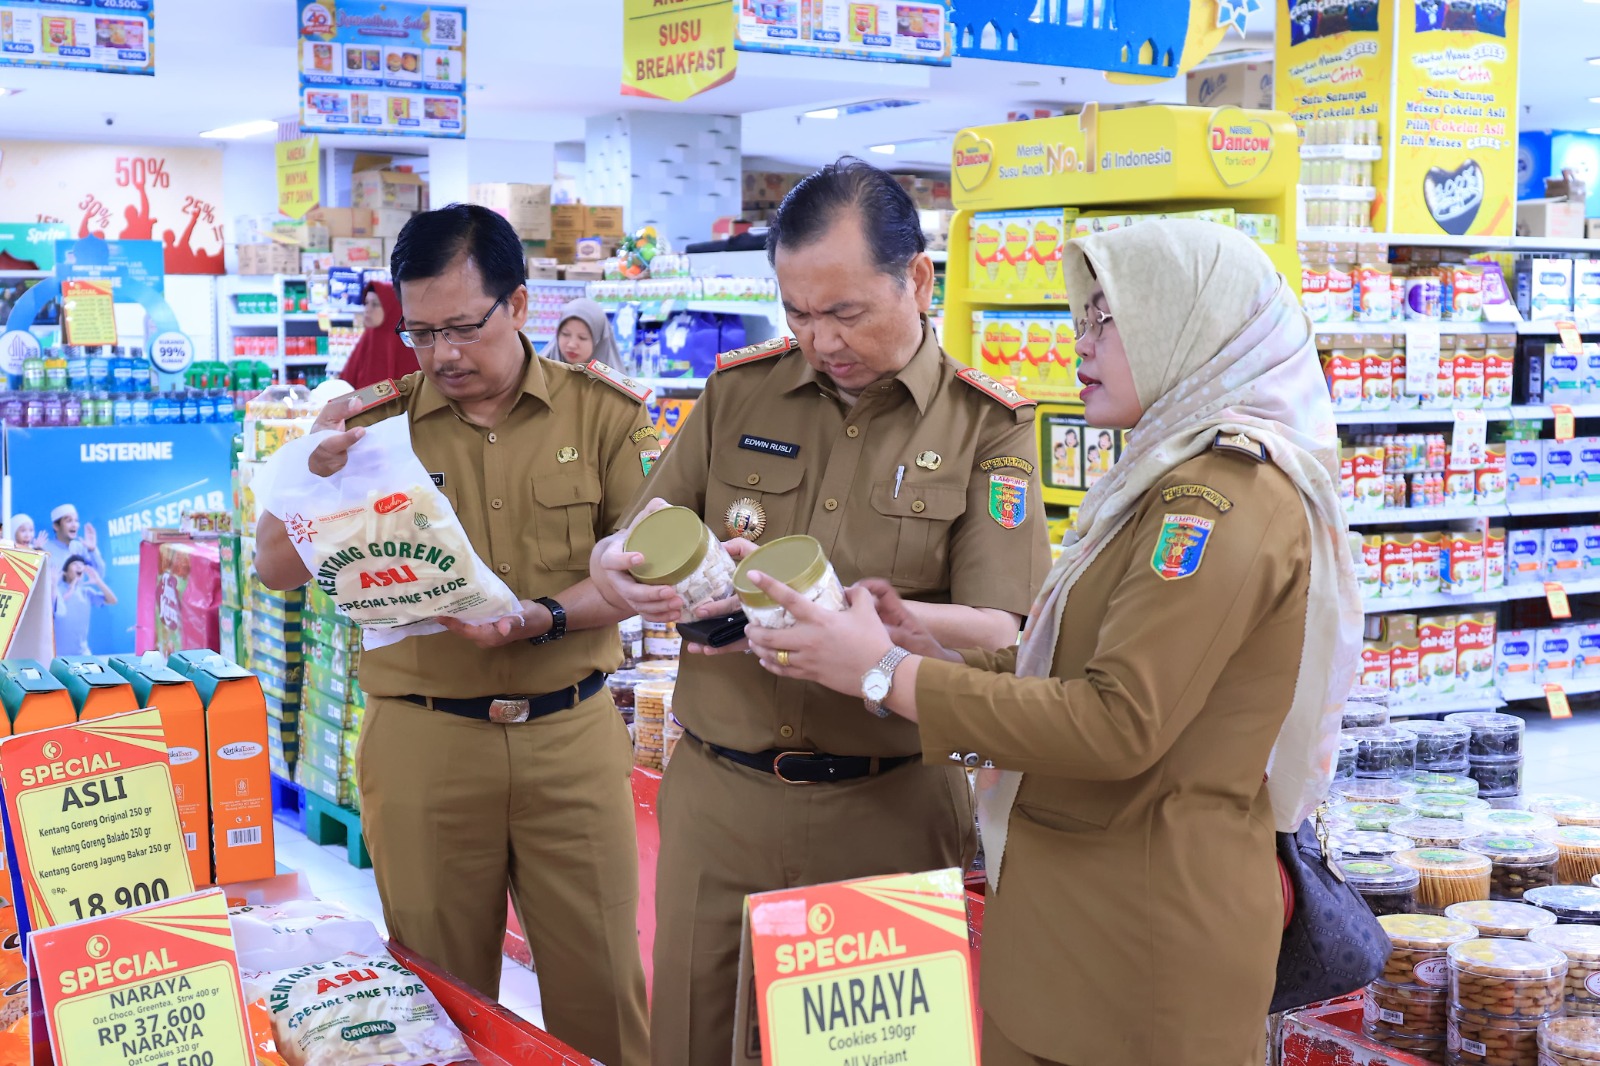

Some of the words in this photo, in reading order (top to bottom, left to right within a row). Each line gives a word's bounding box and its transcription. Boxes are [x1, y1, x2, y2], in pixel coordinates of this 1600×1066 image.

[659, 18, 701, 46] SUSU
[636, 46, 725, 81] BREAKFAST
[1317, 106, 1355, 118] Cokelat
[1358, 104, 1378, 114] Asli
[1405, 102, 1440, 113] Meises
[1443, 104, 1482, 116] Cokelat
[1487, 108, 1505, 118] Asli
[1212, 127, 1270, 151] Dancow
[1406, 119, 1430, 131] Pilih
[1433, 120, 1478, 133] Cokelat
[1483, 123, 1504, 135] Asli
[1016, 142, 1045, 158] Merek
[1400, 135, 1424, 146] Pilih
[1428, 137, 1462, 148] Meises
[956, 150, 990, 167] Dancow
[999, 165, 1019, 179] Susu
[1022, 161, 1045, 176] Anak
[1101, 149, 1112, 169] di
[1114, 147, 1172, 169] Indonesia
[115, 157, 170, 188] 50%
[78, 194, 114, 229] 30%
[181, 195, 216, 224] 25%
[26, 228, 67, 245] Sprite
[159, 347, 186, 357] 99%
[80, 441, 173, 462] LISTERINE
[744, 438, 770, 448] EDWIN
[769, 443, 792, 453] RUSLI
[108, 509, 152, 537] NAFAS
[1167, 515, 1210, 528] LAMPUNG
[317, 546, 366, 596] KENTANG
[368, 541, 456, 572] GORENG
[360, 564, 419, 589] ASLI
[388, 592, 422, 605] PAKE
[424, 577, 468, 600] TELOR
[20, 751, 121, 787] SPECIAL
[61, 776, 128, 812] ASLI
[39, 823, 69, 838] Kentang
[71, 817, 98, 832] Goreng
[99, 809, 128, 825] Original
[129, 808, 144, 819] 250
[145, 807, 152, 817] gr
[51, 842, 80, 857] Kentang
[81, 836, 106, 851] Goreng
[106, 830, 129, 845] Balado
[130, 828, 144, 840] 250
[144, 827, 152, 838] gr
[39, 865, 70, 880] Kentang
[71, 859, 98, 874] Goreng
[99, 852, 126, 867] Jagung
[127, 847, 147, 860] Bakar
[149, 844, 163, 856] 250
[164, 842, 172, 854] gr
[775, 927, 907, 974] SPECIAL
[58, 947, 178, 995] SPECIAL
[317, 969, 380, 994] ASLI
[92, 1016, 107, 1026] Oat
[108, 1008, 135, 1023] Choco,
[137, 1000, 173, 1015] Greentea,
[177, 993, 194, 1004] Strw
[196, 989, 210, 999] 400
[211, 986, 220, 998] gr
[109, 975, 192, 1009] NARAYA
[802, 968, 930, 1036] NARAYA
[288, 996, 343, 1029] SPECIAL
[344, 989, 382, 1002] PAKE
[98, 1023, 127, 1047] RP
[135, 1002, 206, 1037] 37.600
[343, 1021, 394, 1039] ORIGINAL
[828, 1030, 878, 1051] Cookies
[881, 1023, 917, 1043] 190gr
[122, 1023, 204, 1058] NARAYA
[128, 1056, 143, 1066] Oat
[144, 1049, 173, 1063] Cookies
[174, 1045, 190, 1056] 320
[192, 1042, 201, 1052] gr
[843, 1056, 860, 1066] All
[862, 1050, 908, 1066] Variant
